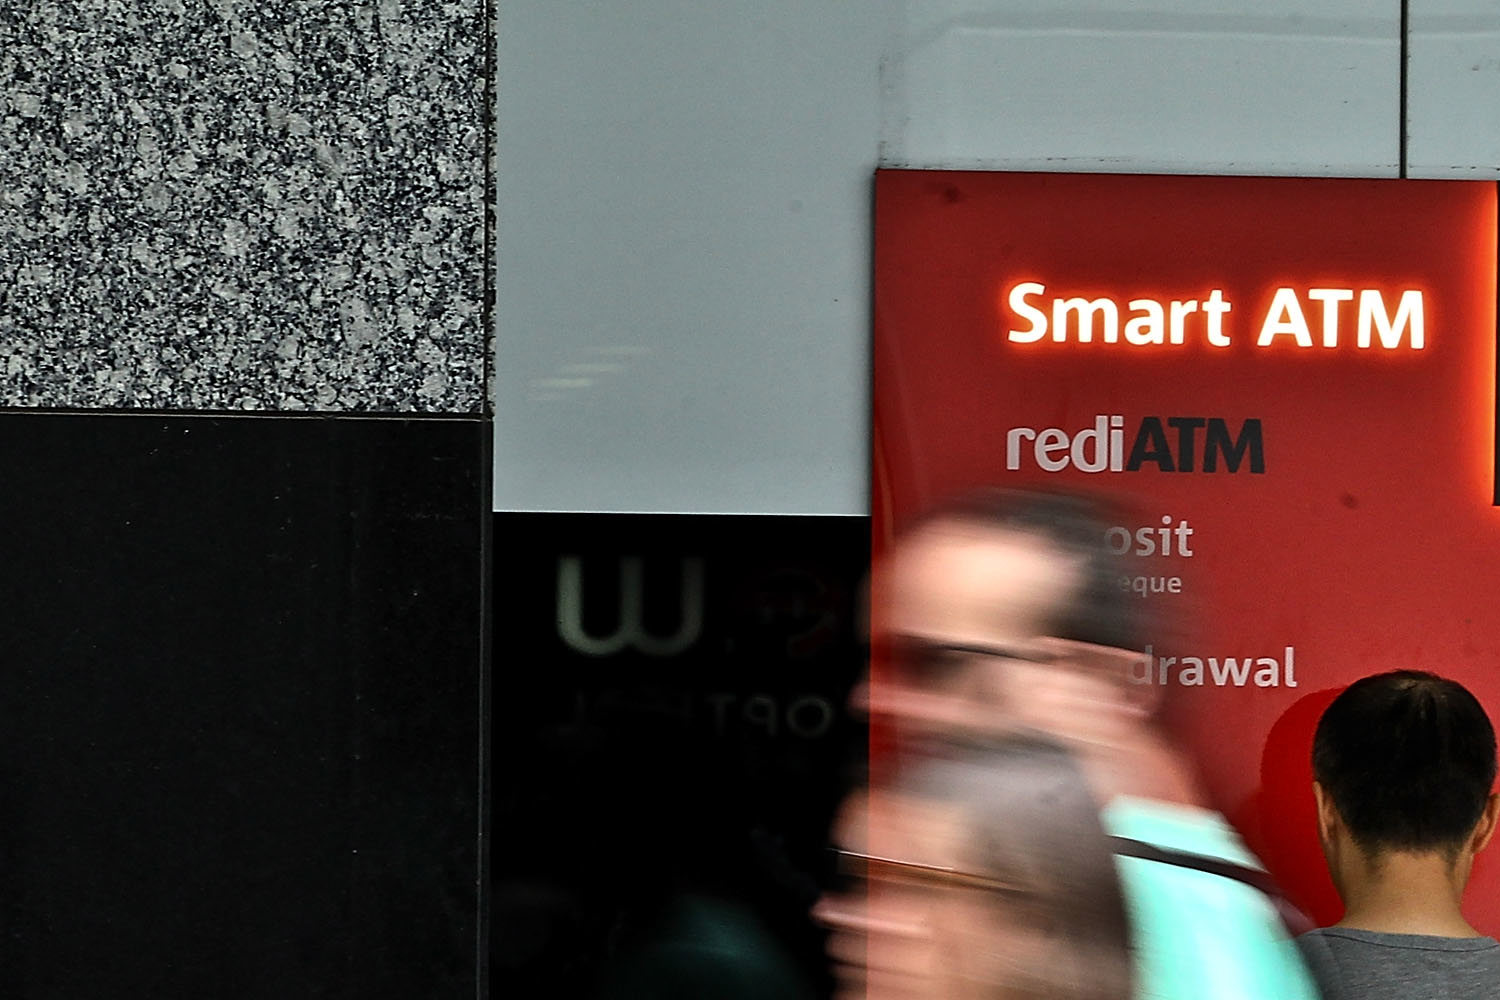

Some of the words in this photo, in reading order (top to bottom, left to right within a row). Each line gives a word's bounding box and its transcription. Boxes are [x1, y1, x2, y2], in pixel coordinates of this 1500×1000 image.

[1007, 281, 1232, 348] Smart
[1257, 287, 1426, 350] ATM
[1006, 415, 1265, 474] rediATM
[1104, 515, 1194, 557] osit
[1118, 576, 1182, 598] eque
[1129, 645, 1298, 688] drawal
